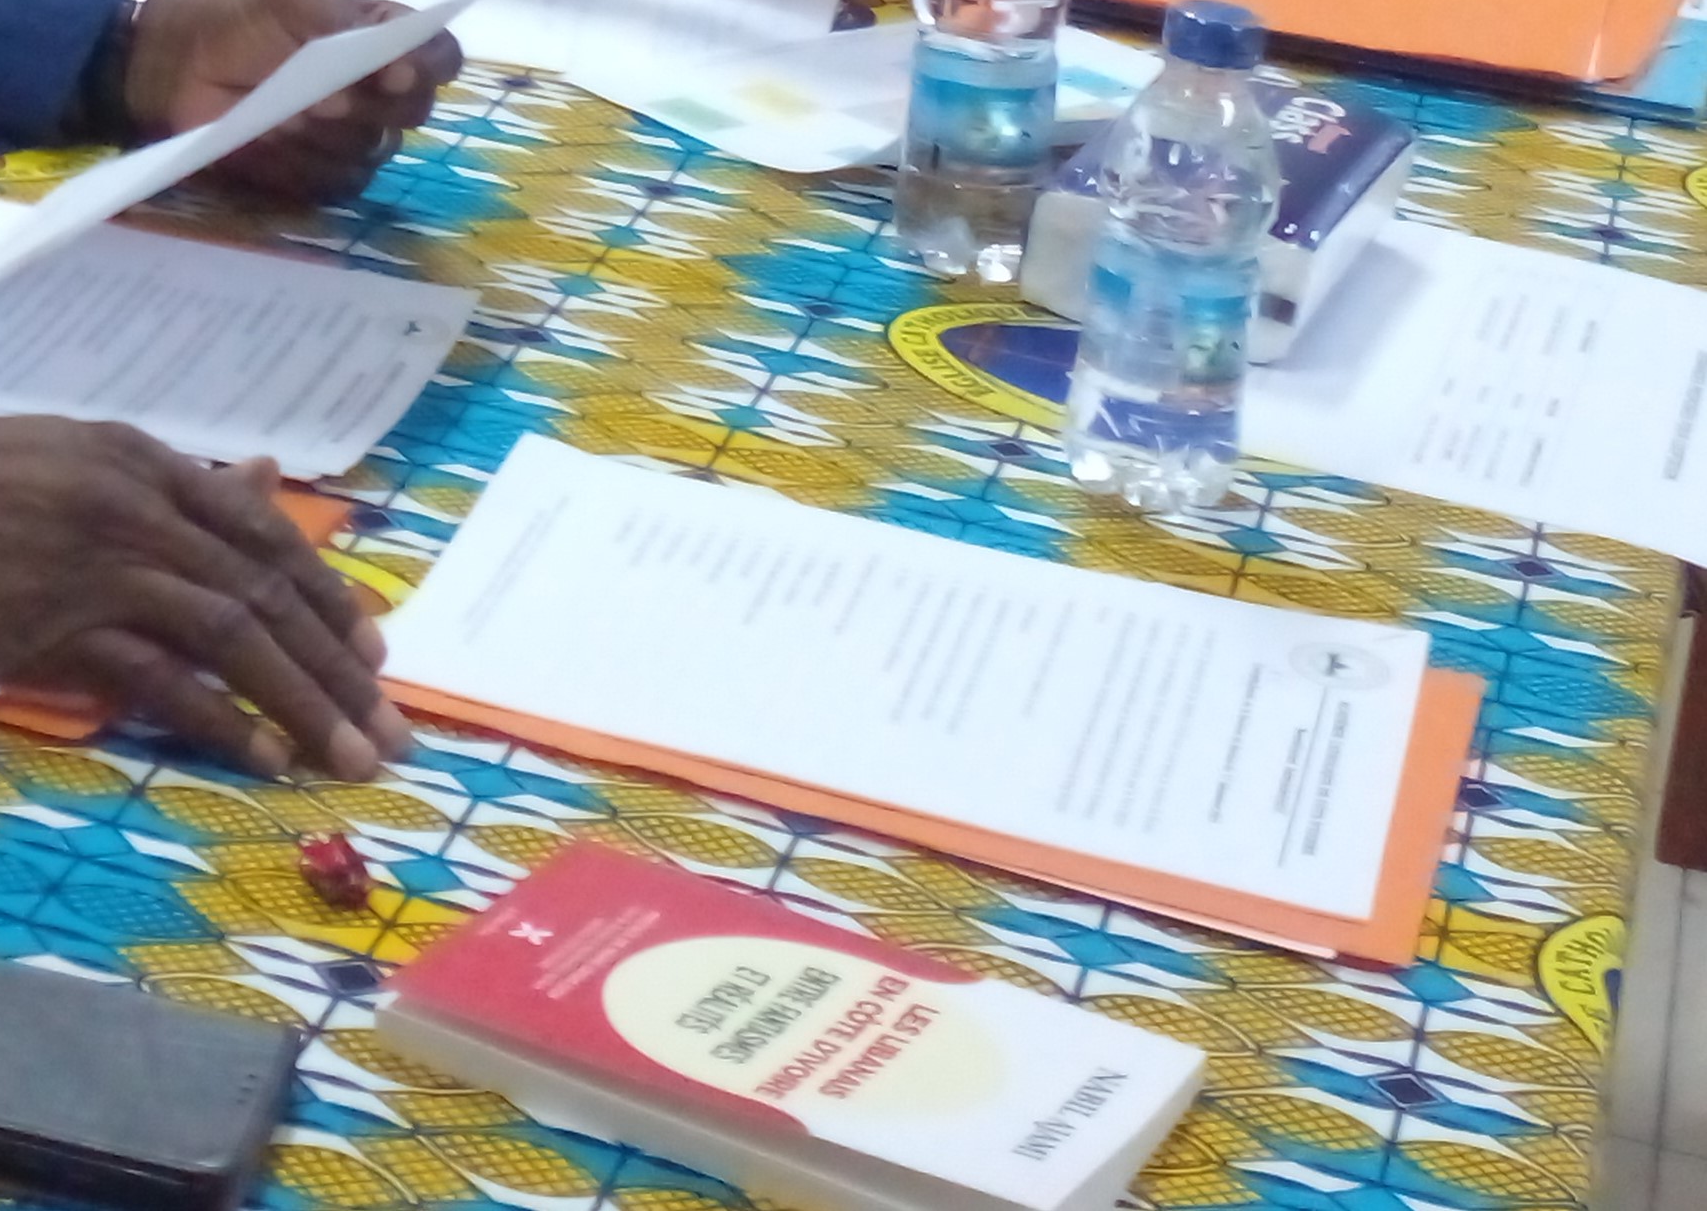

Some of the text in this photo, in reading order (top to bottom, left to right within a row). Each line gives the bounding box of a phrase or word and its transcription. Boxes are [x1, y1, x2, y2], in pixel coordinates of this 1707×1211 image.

[735, 965, 772, 987] ET
[869, 975, 911, 1003] EN
[709, 966, 842, 1064] ENTRE FANTASMES
[818, 1002, 940, 1099] LES LIBANAIS
[755, 1038, 842, 1099] D'IVOIRE
[1011, 1066, 1128, 1160] NABIL AJAMI
